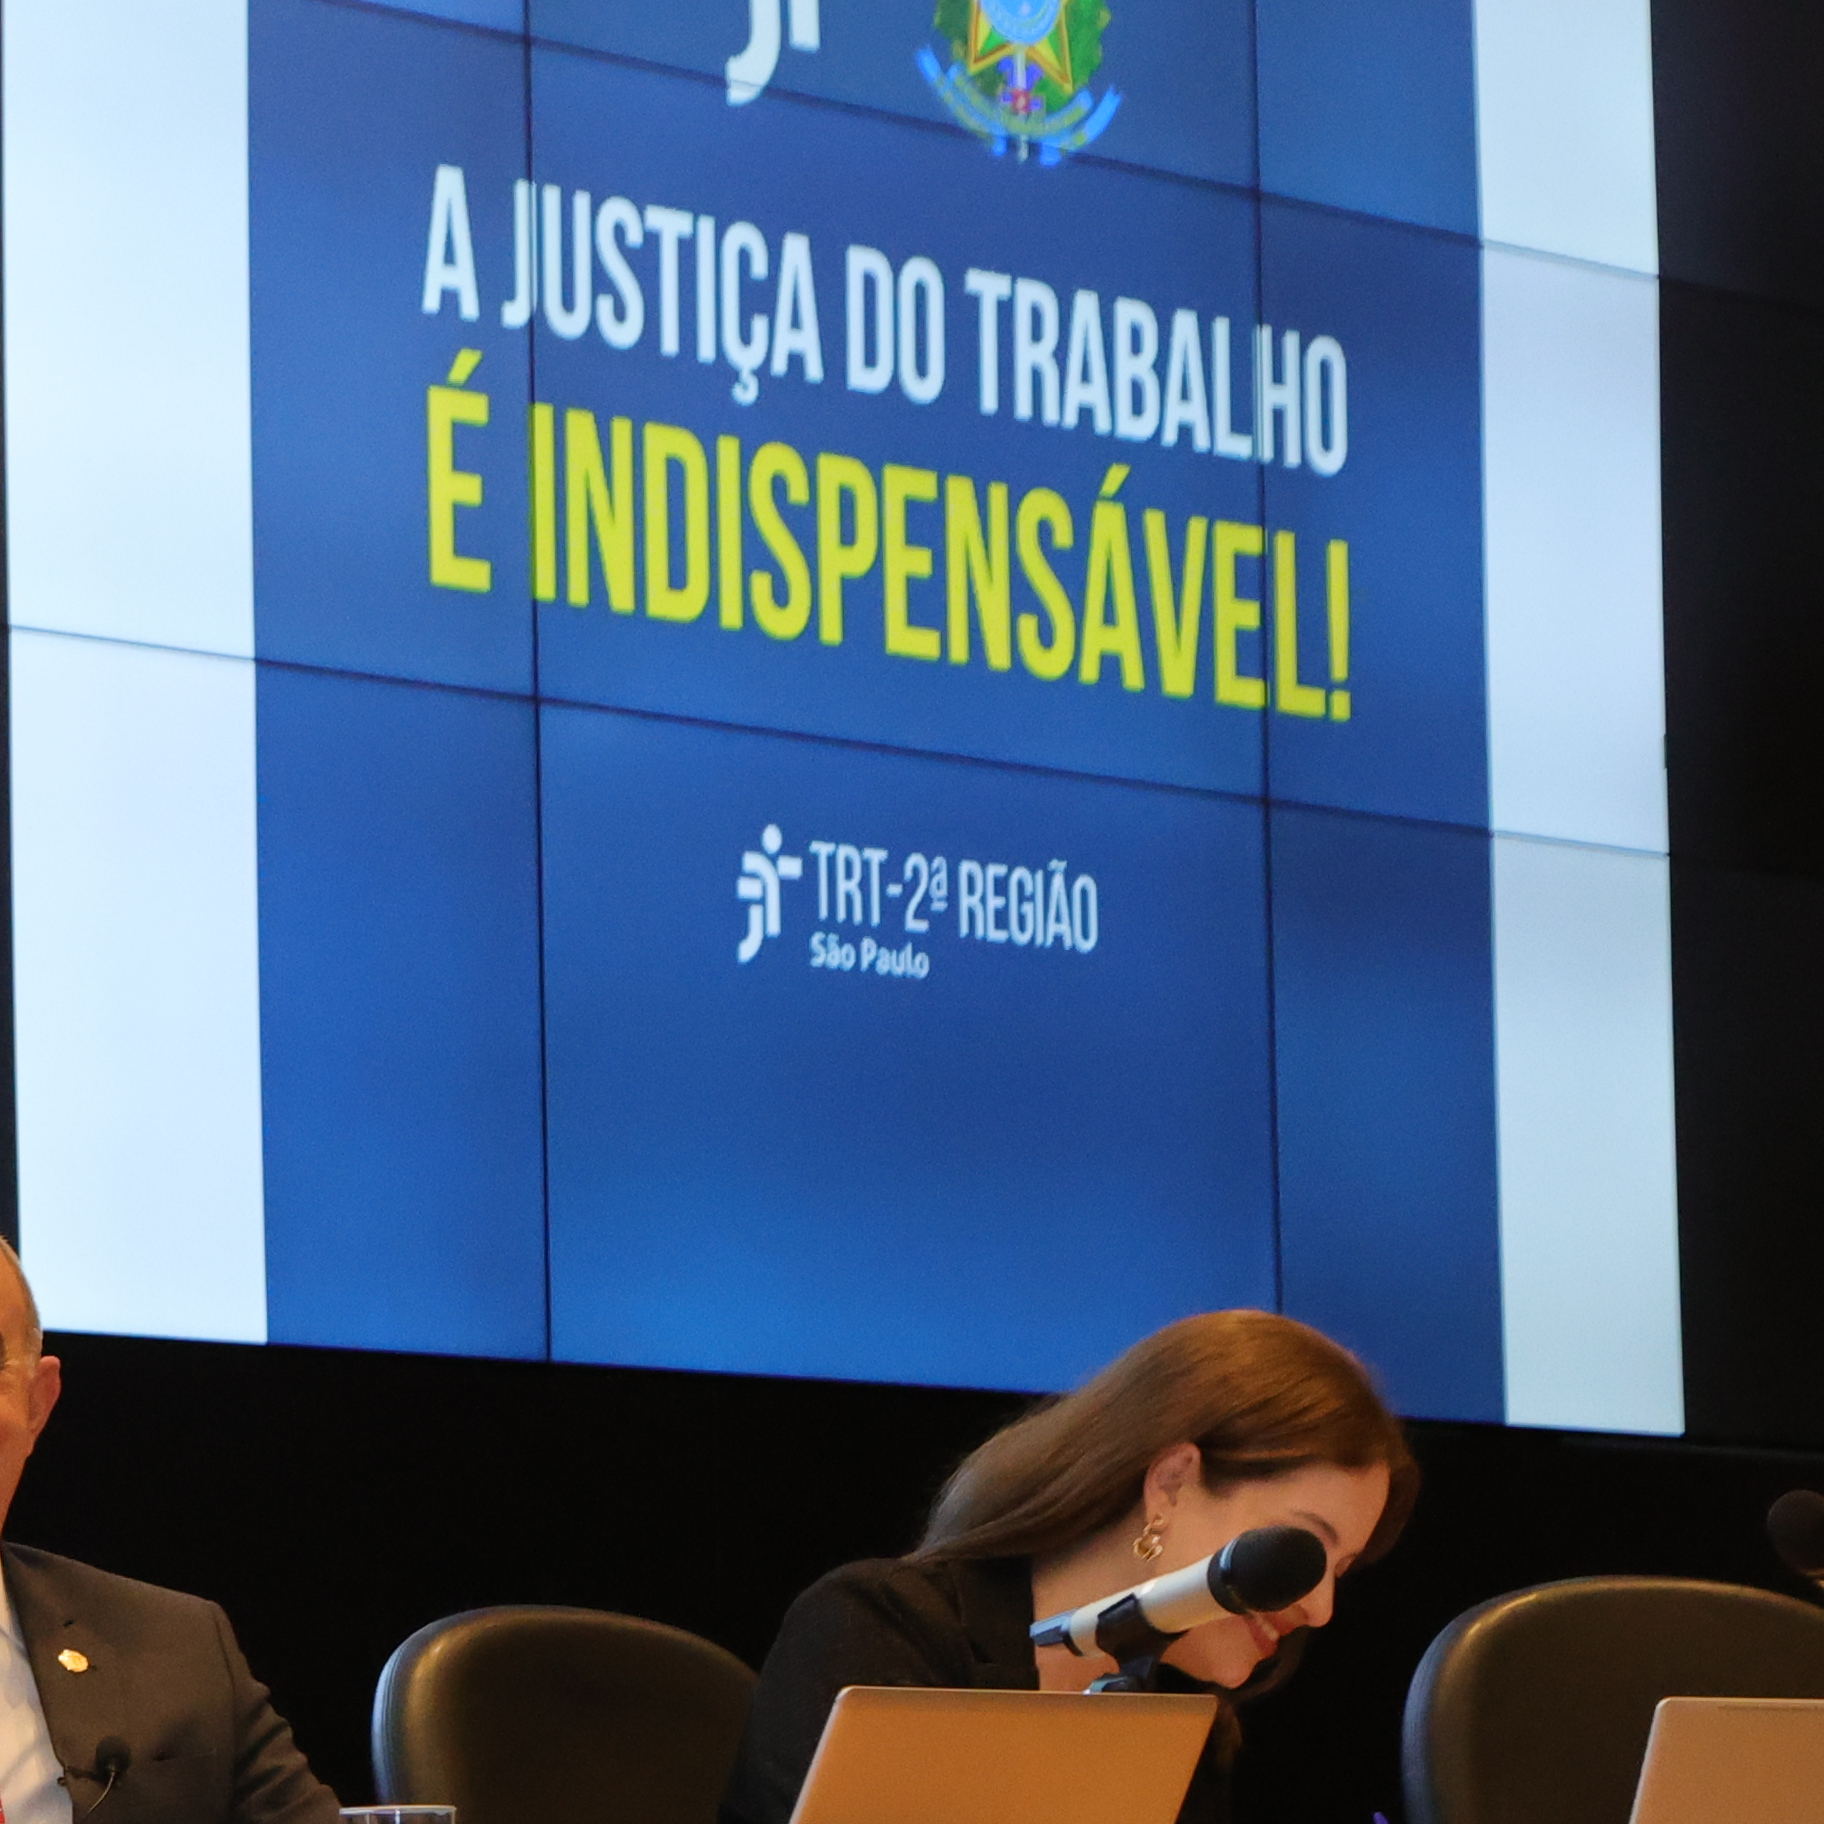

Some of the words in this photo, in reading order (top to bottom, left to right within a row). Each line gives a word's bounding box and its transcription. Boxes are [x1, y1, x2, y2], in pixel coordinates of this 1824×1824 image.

[421, 164, 480, 321] A
[502, 178, 824, 405] JUSTIÇA
[845, 244, 946, 404] DO
[964, 266, 1349, 478] TRABALHO
[426, 349, 492, 592] É
[529, 400, 1352, 722] INDISPENSÁVEL!
[810, 931, 856, 972] São
[860, 935, 931, 980] Paulo
[958, 858, 1100, 954] REGIÃO
